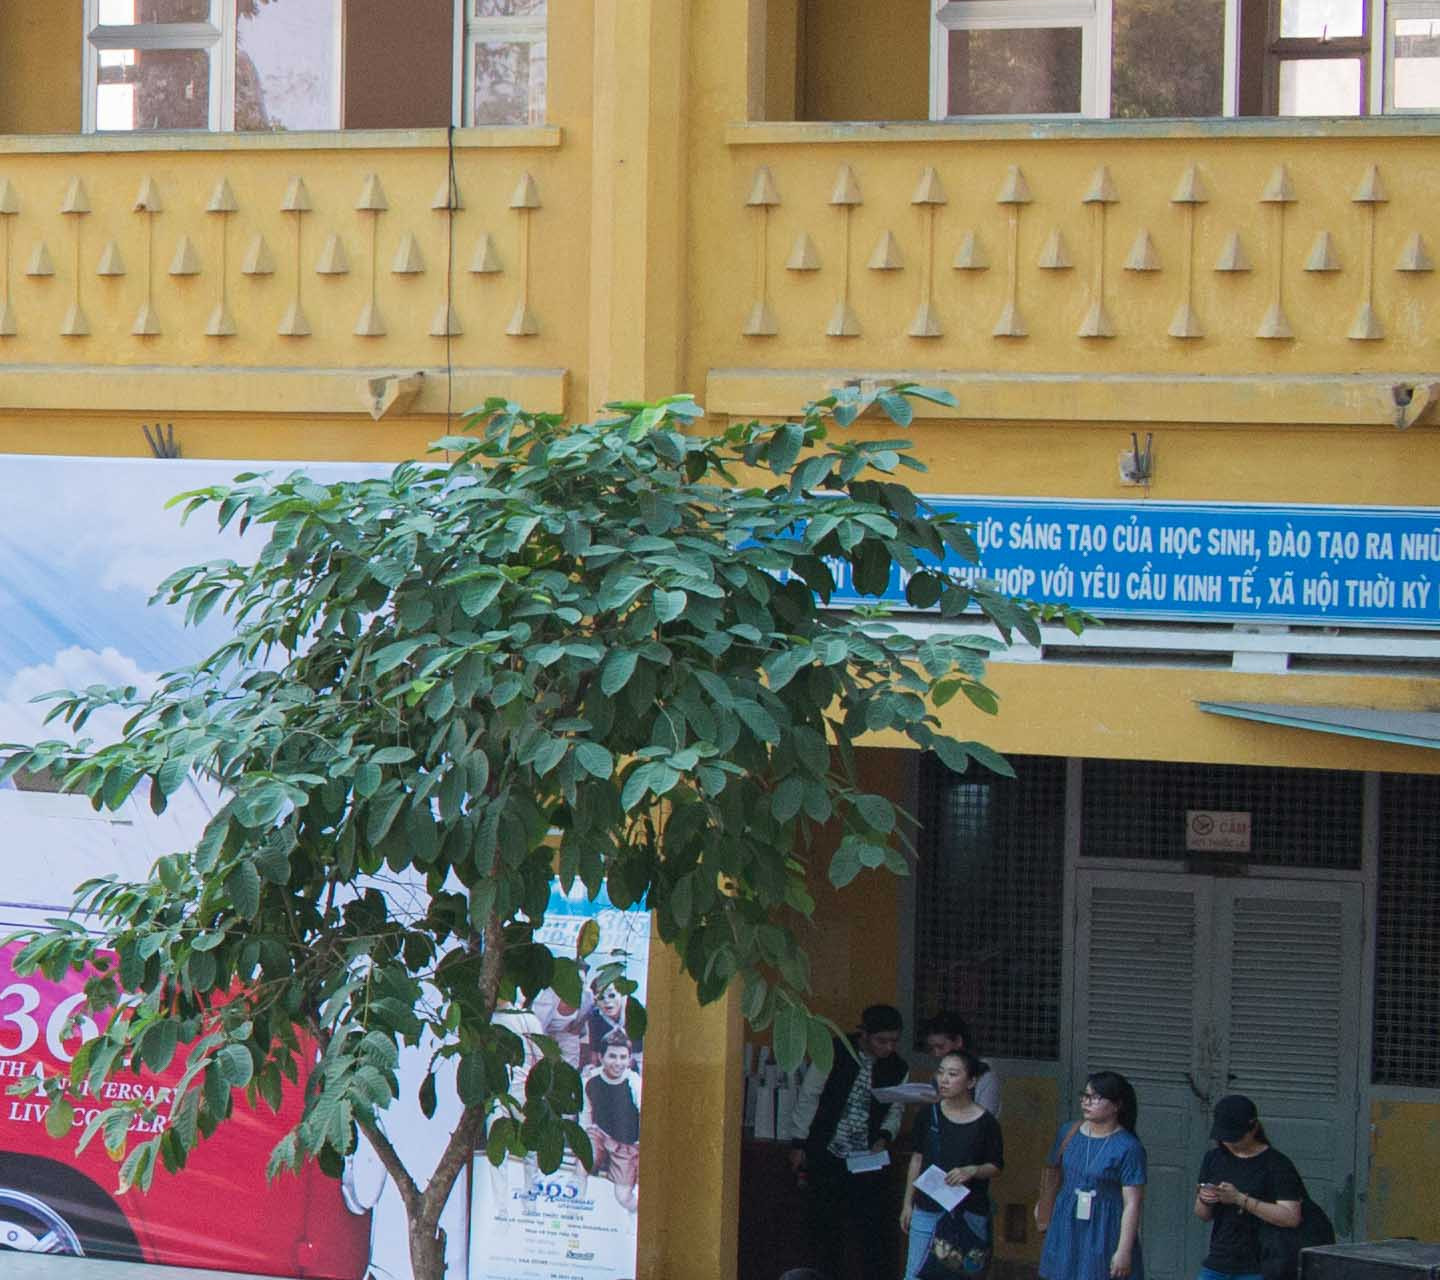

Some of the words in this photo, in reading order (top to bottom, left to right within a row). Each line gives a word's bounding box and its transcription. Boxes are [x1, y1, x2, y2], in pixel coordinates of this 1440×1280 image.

[1008, 515, 1061, 551] SÁNG
[1066, 523, 1108, 558] TẠO
[1112, 515, 1153, 554] CỦA
[1159, 527, 1202, 560] HỌC
[1207, 528, 1261, 562] SINH,
[1267, 522, 1312, 560] ĐÀO
[1317, 531, 1360, 565] TẠO
[1365, 532, 1394, 561] RA
[995, 565, 1036, 598] HỢP
[1041, 562, 1074, 599] VỚI
[1080, 564, 1120, 600] YÊU
[1126, 562, 1167, 601] CẦU
[1173, 574, 1222, 603] KINH
[1227, 566, 1262, 609] TẾ,
[1268, 571, 1296, 606] XÃ
[1303, 570, 1339, 612] HỘI
[1345, 572, 1395, 609] THỜI
[1401, 574, 1432, 610] KỲ
